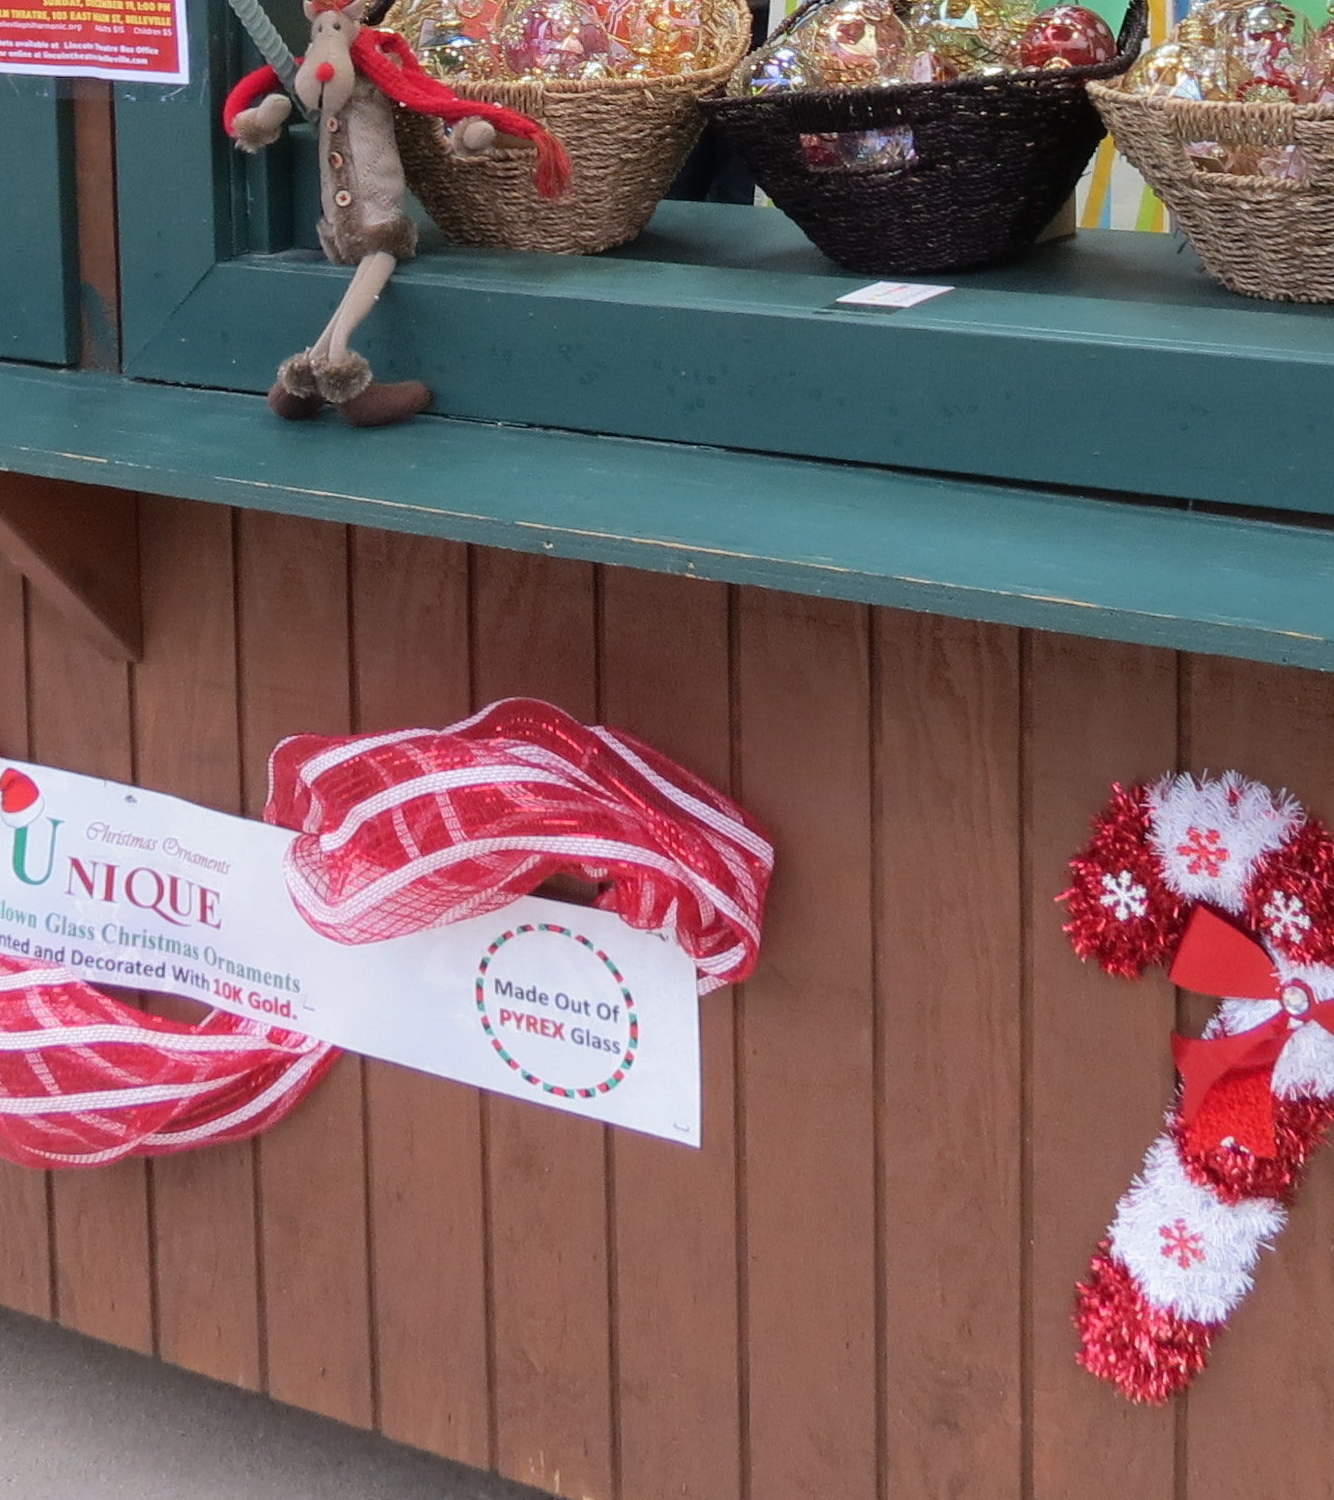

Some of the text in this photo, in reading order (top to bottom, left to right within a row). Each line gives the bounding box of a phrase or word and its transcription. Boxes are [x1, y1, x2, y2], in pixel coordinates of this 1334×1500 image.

[70, 11, 91, 22] EAST
[125, 14, 172, 26] BELLEVILLE
[136, 1, 156, 12] 1:00
[15, 39, 49, 49] available
[63, 41, 95, 51] Lincoln
[162, 27, 173, 37] $5
[86, 821, 231, 875] Christmas Ornaments
[12, 817, 222, 929] UNIQUE
[44, 912, 96, 941] Glass
[101, 924, 200, 960] Christmas
[204, 945, 301, 994] Ornaments
[34, 939, 65, 964] and
[71, 949, 166, 980] Decorated
[171, 963, 210, 993] With
[213, 977, 244, 1005] 10K
[247, 993, 298, 1020] Gold.
[494, 978, 620, 1023] Made Out Of
[499, 1008, 621, 1055] PYREX Glass
